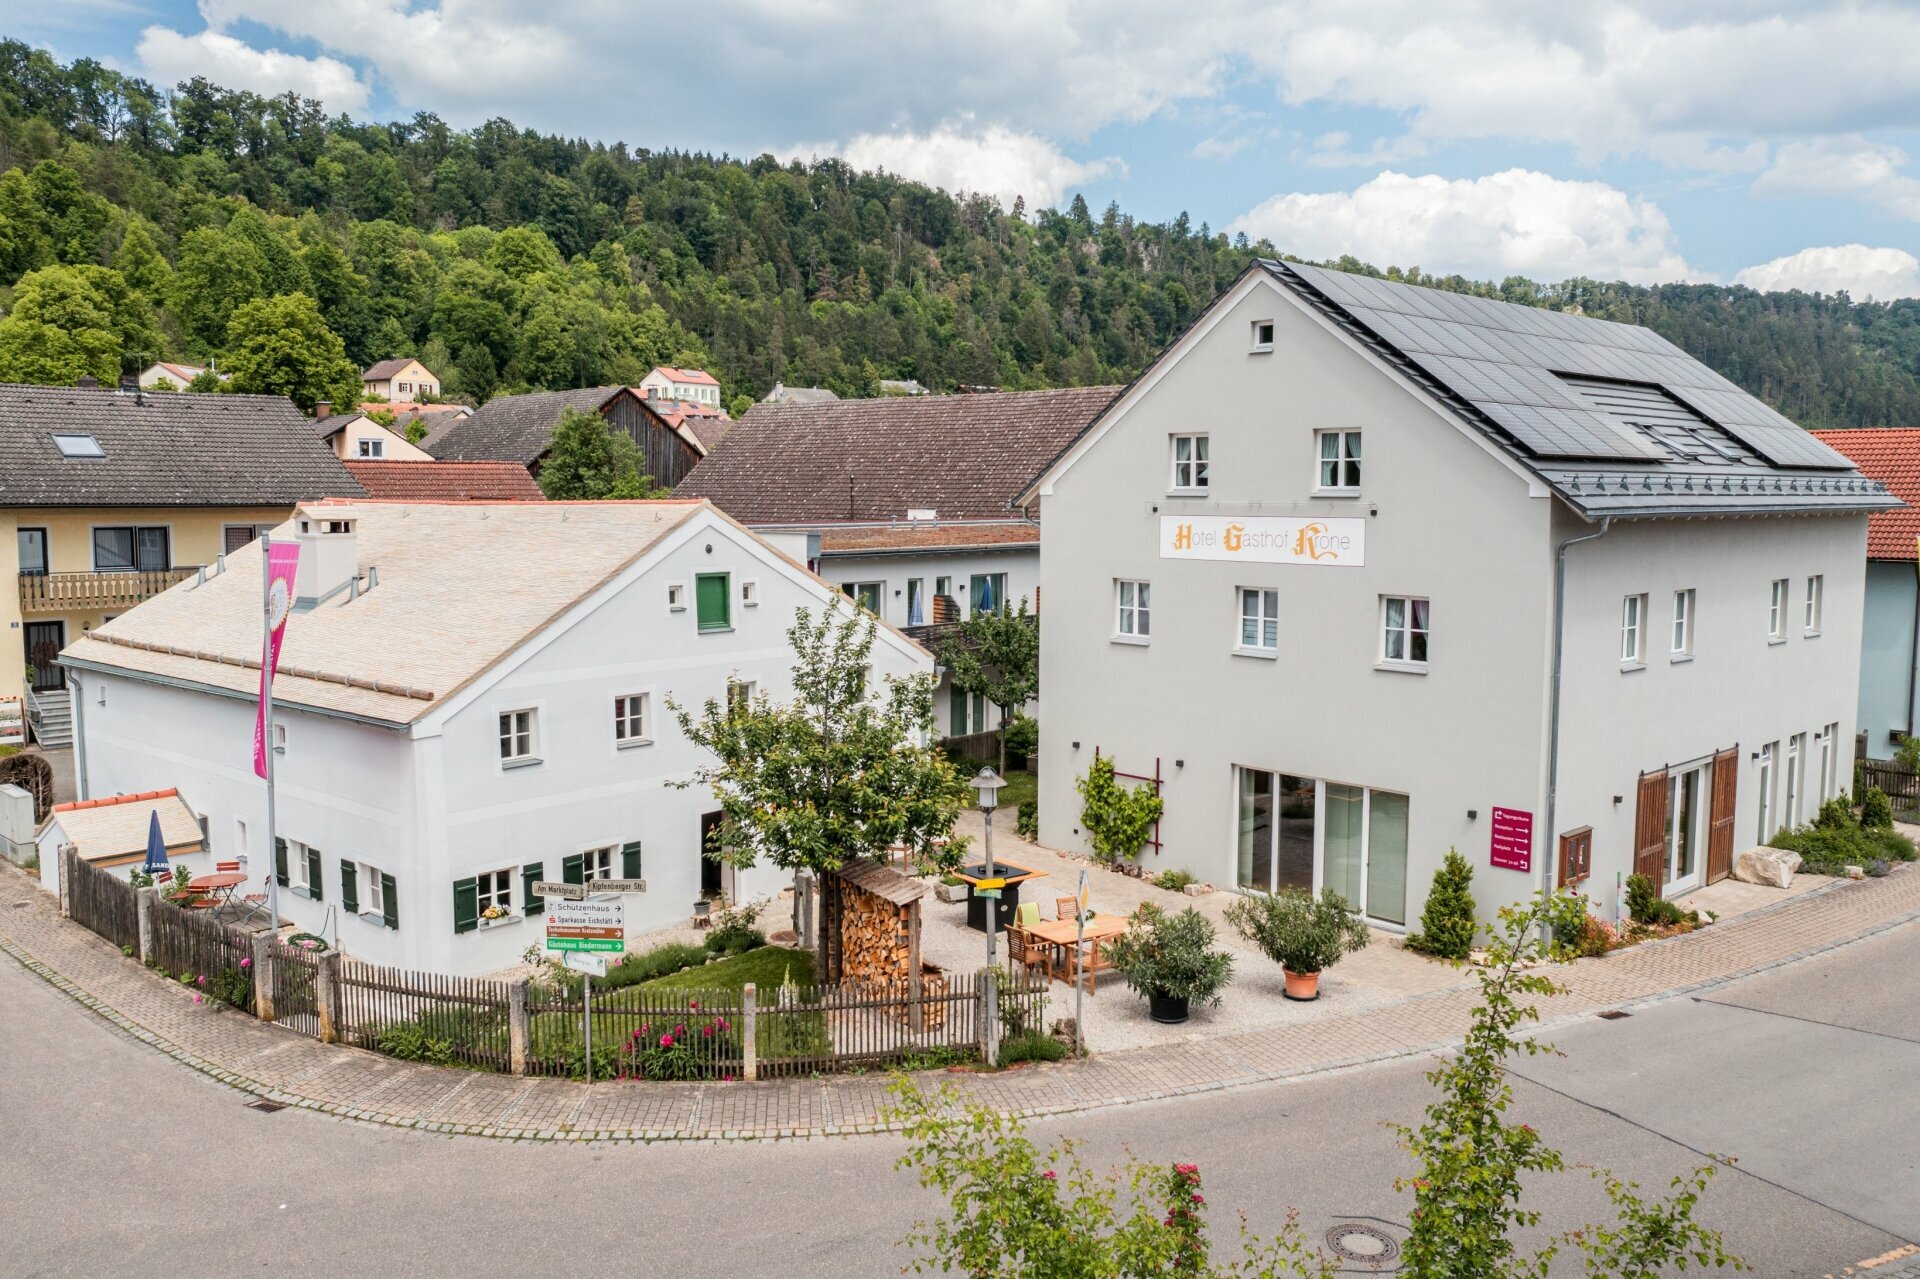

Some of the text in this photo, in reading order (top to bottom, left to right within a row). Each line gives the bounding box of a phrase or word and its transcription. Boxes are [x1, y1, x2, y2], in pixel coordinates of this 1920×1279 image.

[1172, 521, 1351, 560] Hotel Gasthof Krone
[548, 886, 577, 896] Marktplatz
[592, 882, 644, 891] Kipfenberger Str.
[557, 903, 610, 912] Schützenhaus
[557, 916, 587, 924] Sparkasse
[588, 916, 613, 924] Eichstätt
[548, 940, 612, 949] Gästehaus Biedermann
